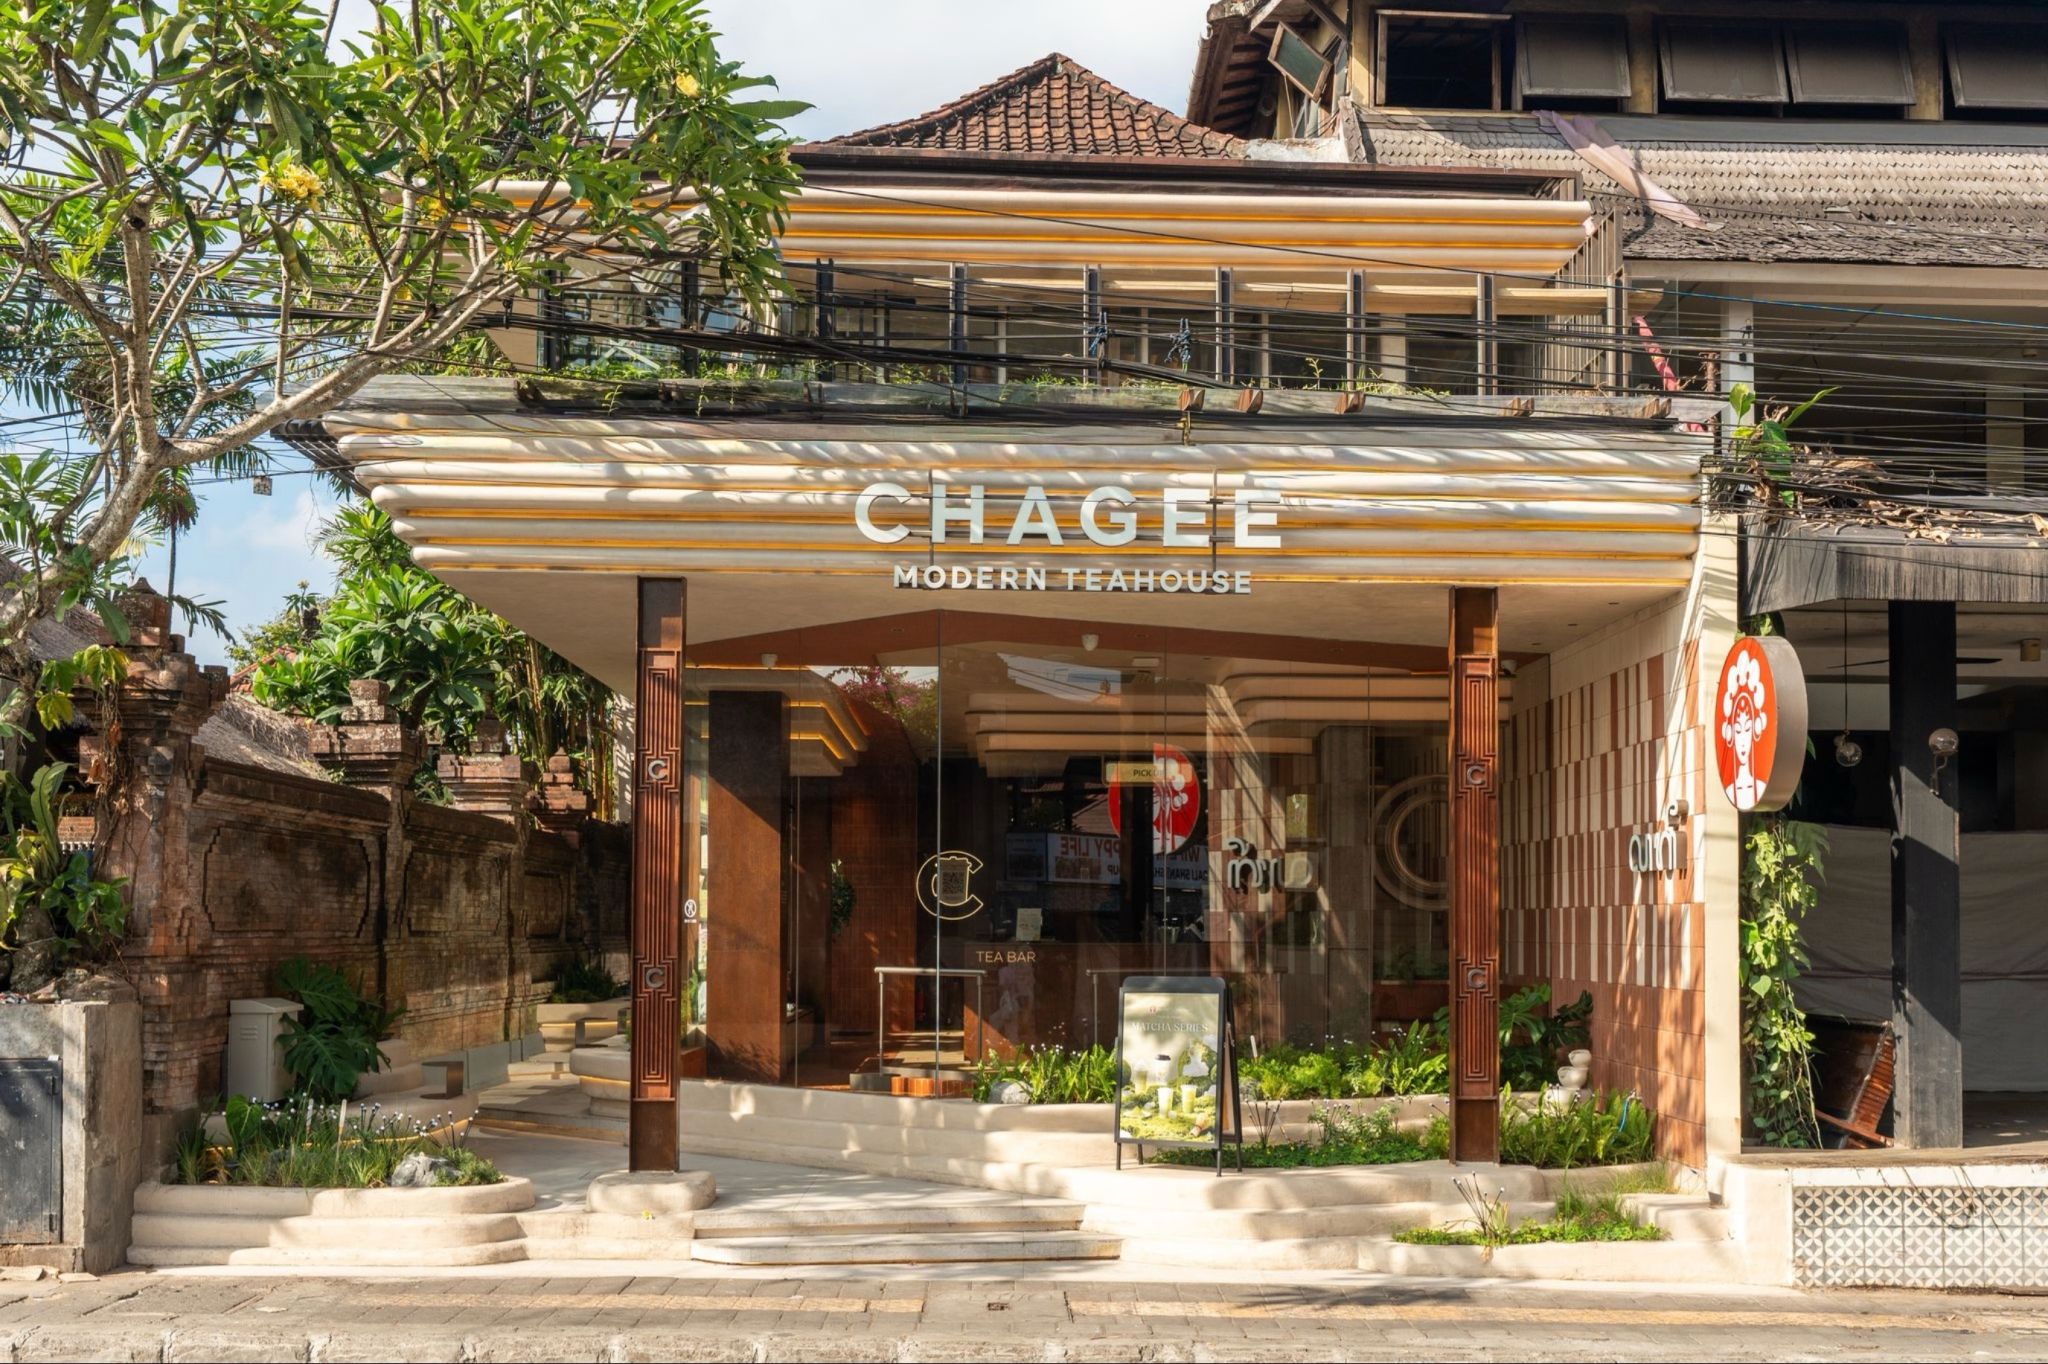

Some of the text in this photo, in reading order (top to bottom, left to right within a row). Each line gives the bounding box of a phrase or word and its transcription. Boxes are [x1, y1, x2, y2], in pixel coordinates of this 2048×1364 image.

[855, 482, 1282, 548] CHAGEE
[893, 564, 1252, 595] MODERN TEAHOUSE
[1133, 769, 1151, 777] PICK
[976, 950, 1036, 963] TEA BAR
[1132, 1022, 1208, 1033] MATCHA SERIES
